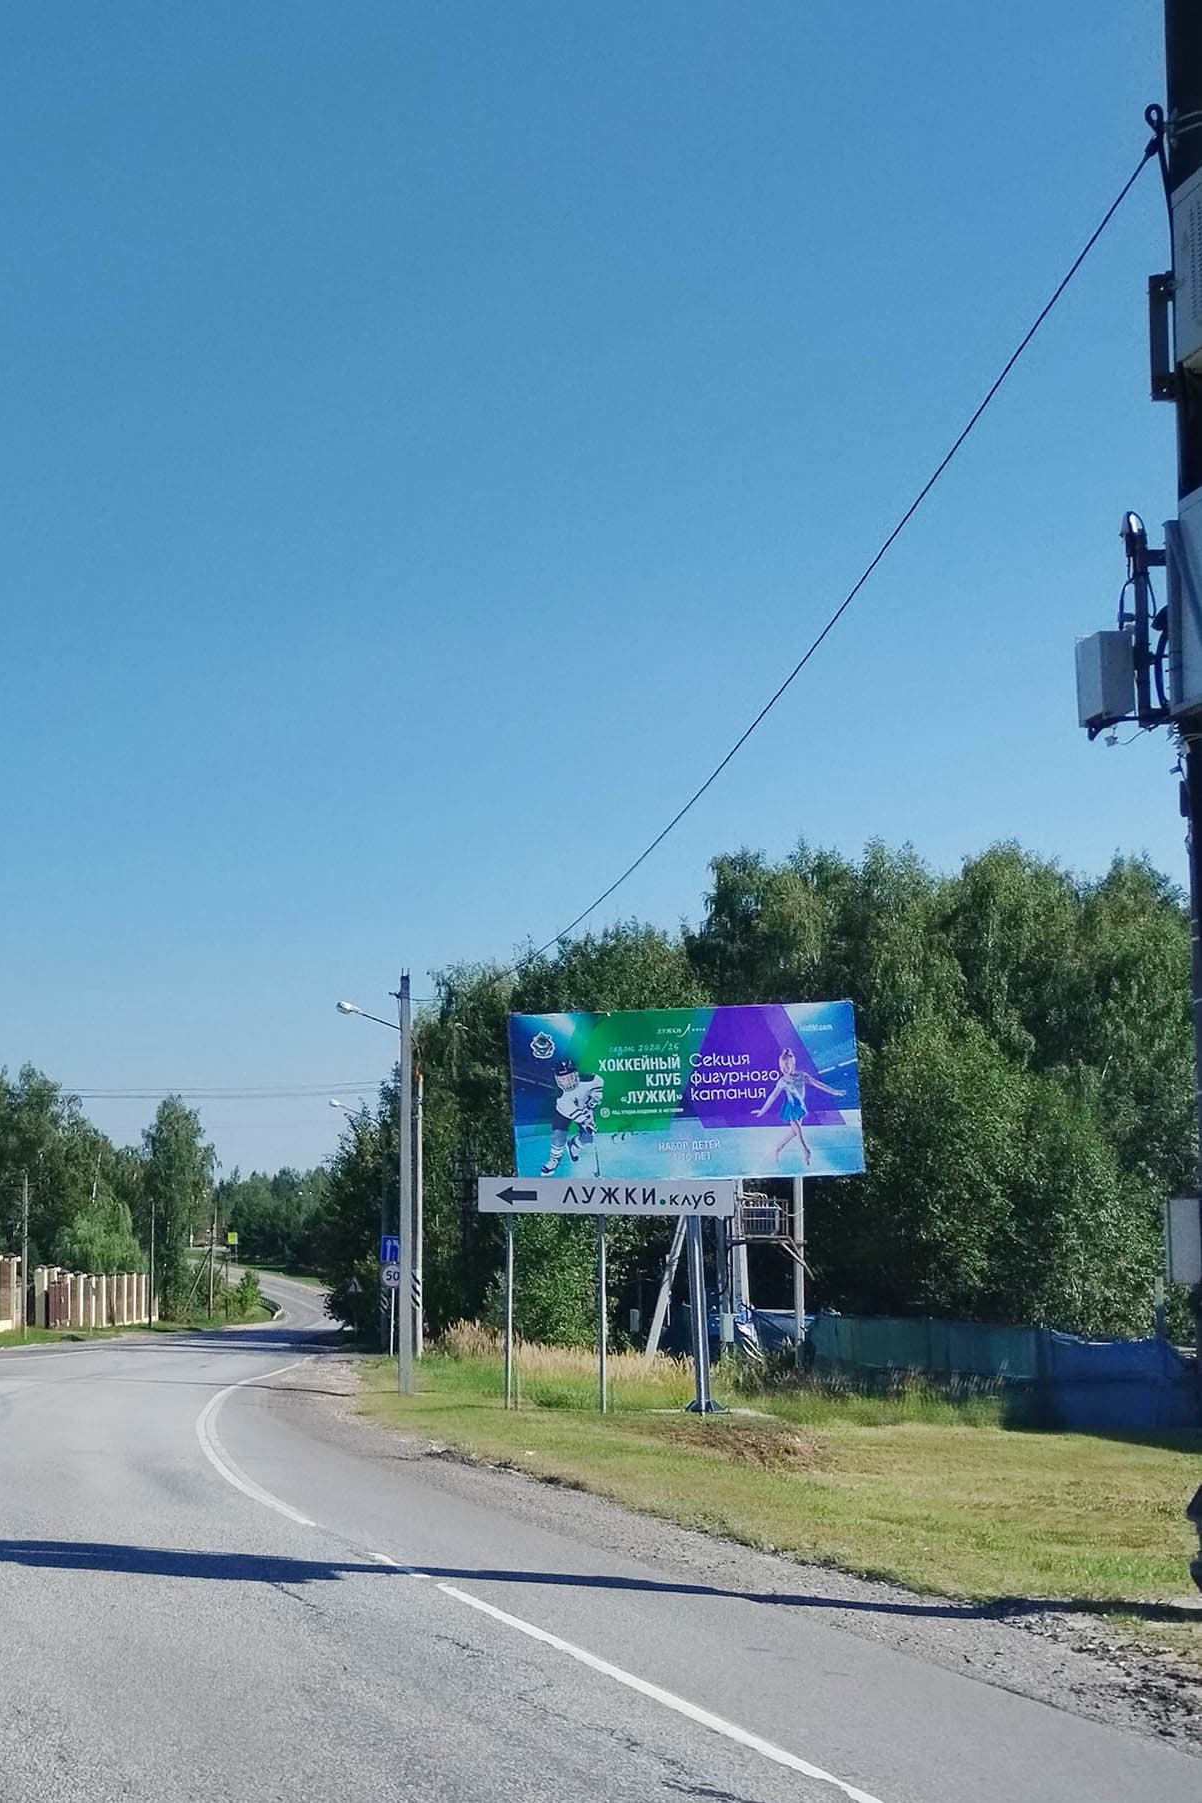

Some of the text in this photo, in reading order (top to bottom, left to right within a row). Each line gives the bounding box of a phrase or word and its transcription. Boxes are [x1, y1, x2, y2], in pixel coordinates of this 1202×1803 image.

[598, 1053, 680, 1072] ХОККЕЙНЫЙ
[689, 1052, 750, 1067] Секция
[645, 1073, 681, 1087] КЛУБ
[690, 1070, 780, 1087] фигурного
[620, 1089, 683, 1104] «ЛУЖКИ»
[690, 1087, 767, 1101] катания
[562, 1186, 716, 1209] ЛУЖКИ.клуб
[386, 1270, 400, 1281] 50
